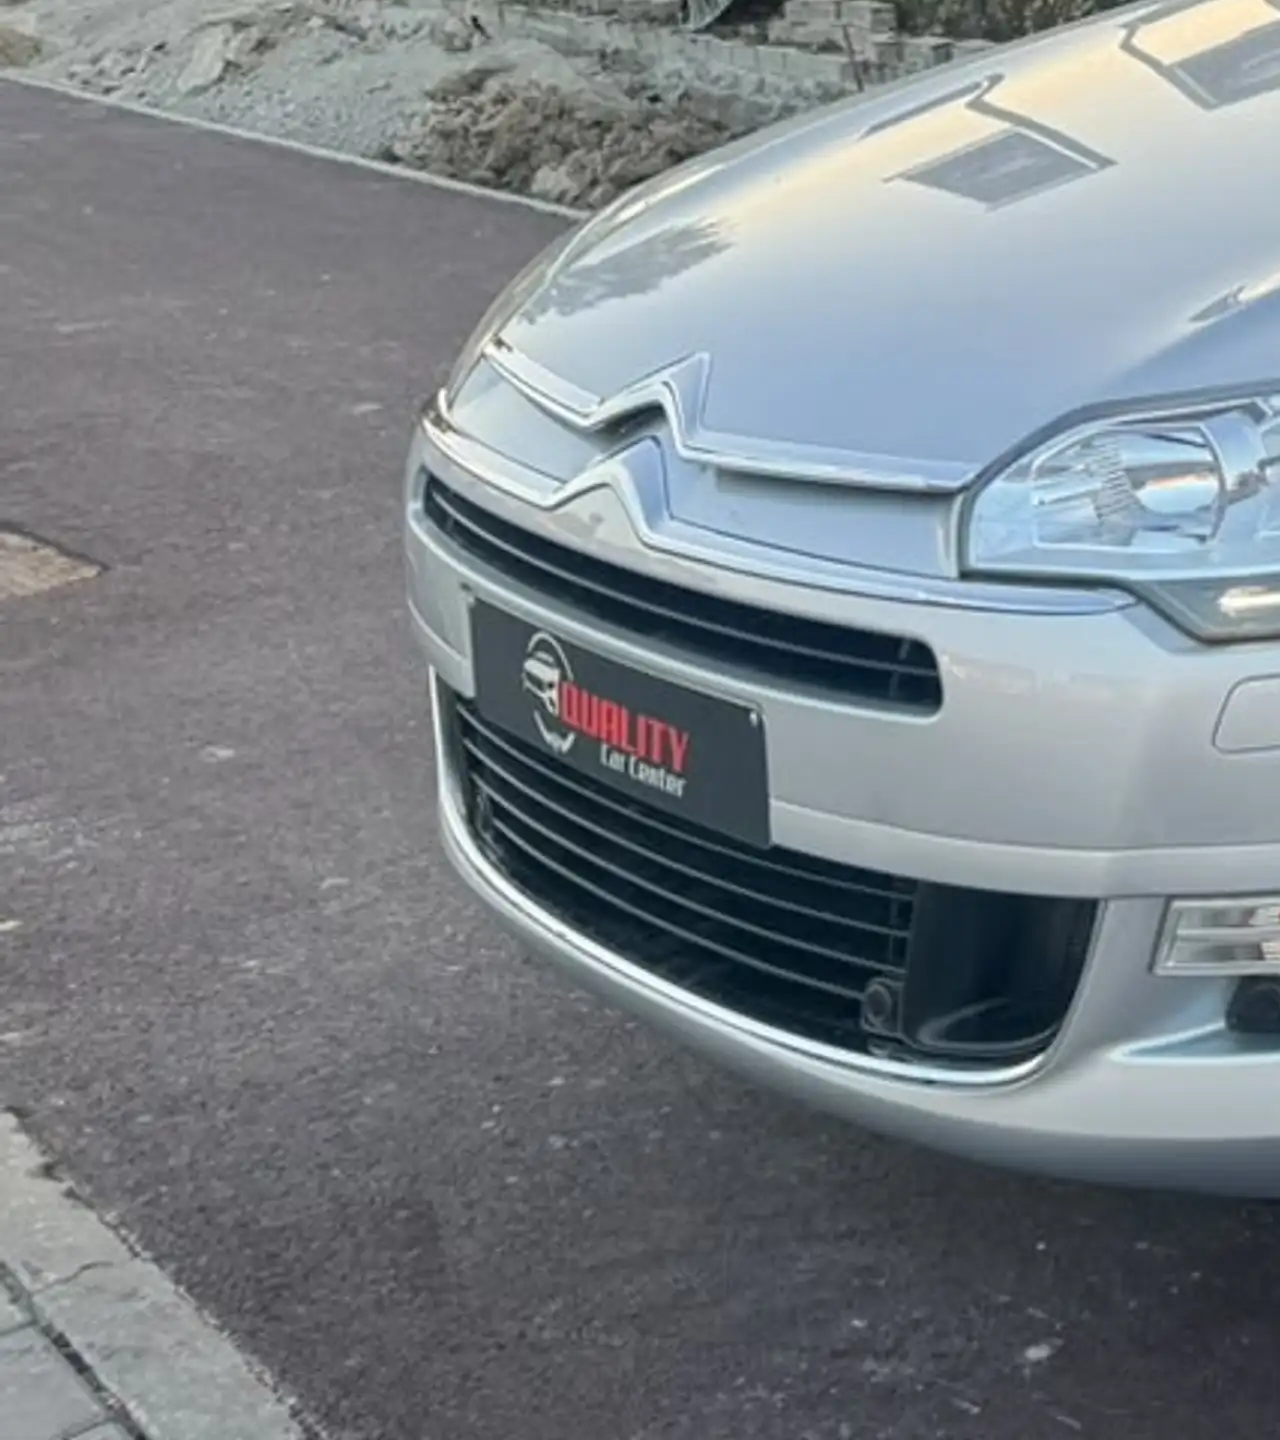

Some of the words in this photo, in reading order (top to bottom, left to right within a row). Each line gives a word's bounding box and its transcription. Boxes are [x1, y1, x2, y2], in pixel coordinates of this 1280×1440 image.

[559, 679, 690, 774] QUALITY
[600, 742, 626, 773] Car
[628, 753, 688, 798] Center
